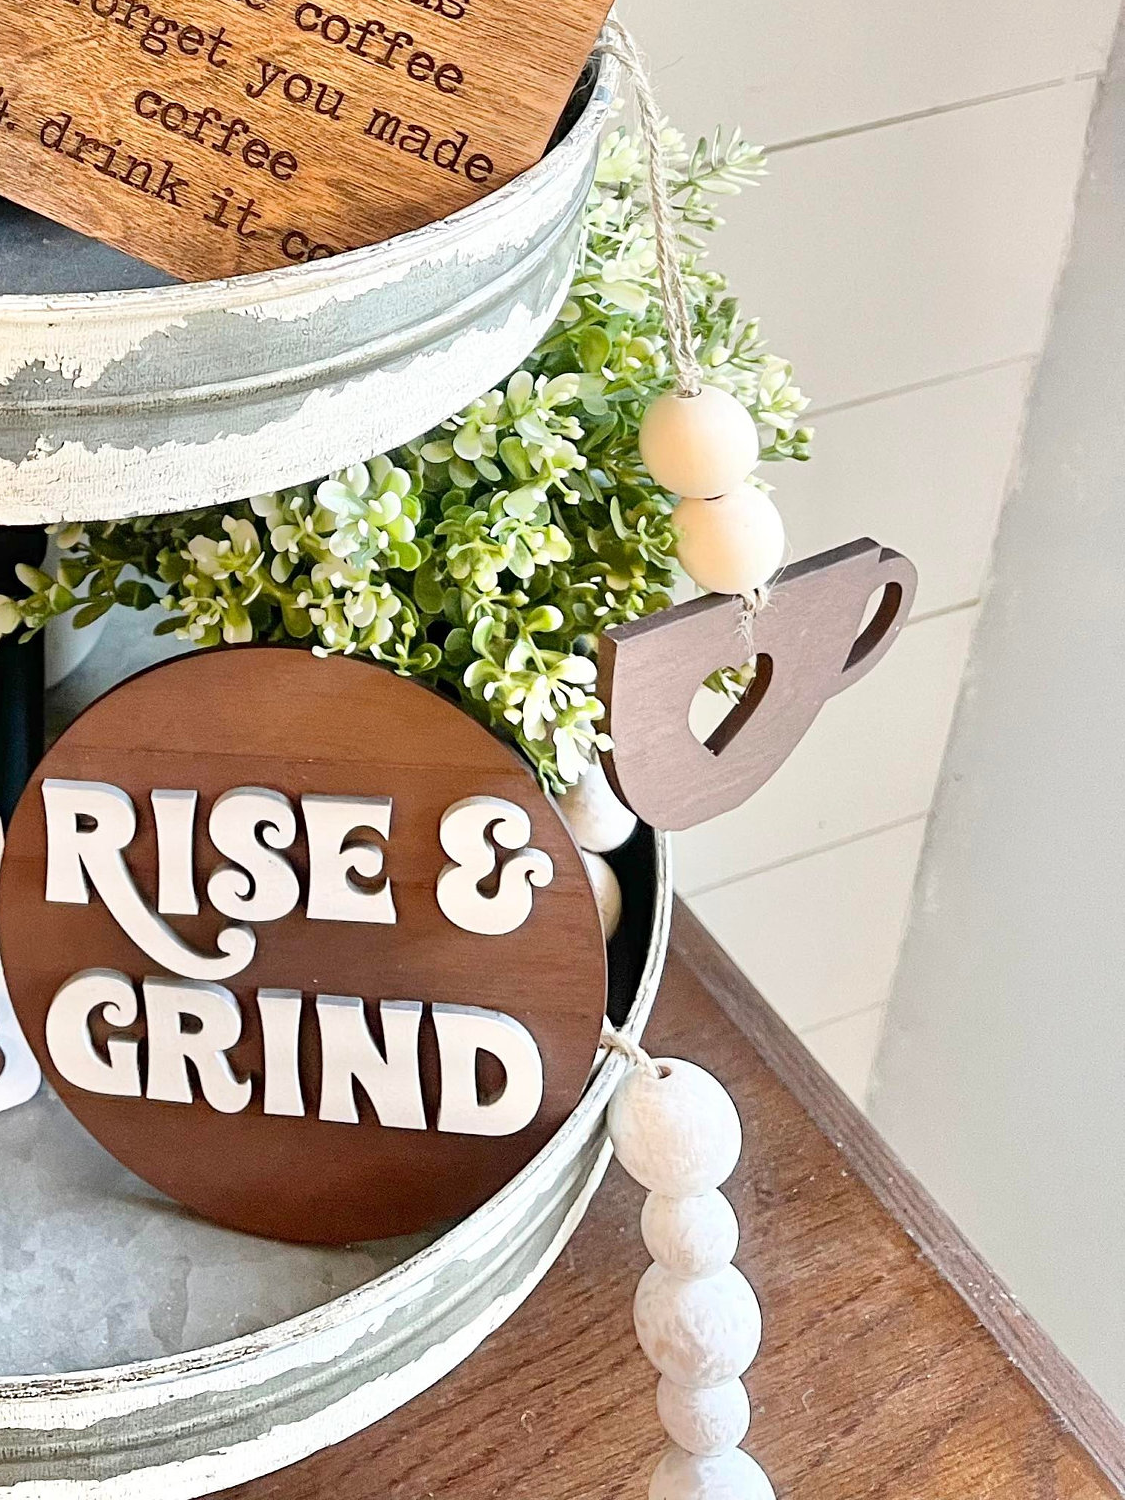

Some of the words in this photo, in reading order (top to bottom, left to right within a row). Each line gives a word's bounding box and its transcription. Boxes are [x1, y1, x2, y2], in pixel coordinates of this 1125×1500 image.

[294, 1, 465, 95] coffee
[39, 111, 182, 207] drink
[203, 186, 263, 239] it
[133, 87, 300, 182] coffee
[246, 55, 348, 122] you
[364, 106, 495, 185] made
[41, 778, 396, 981] RISE
[436, 795, 554, 936] &
[45, 967, 544, 1137] GRIND
